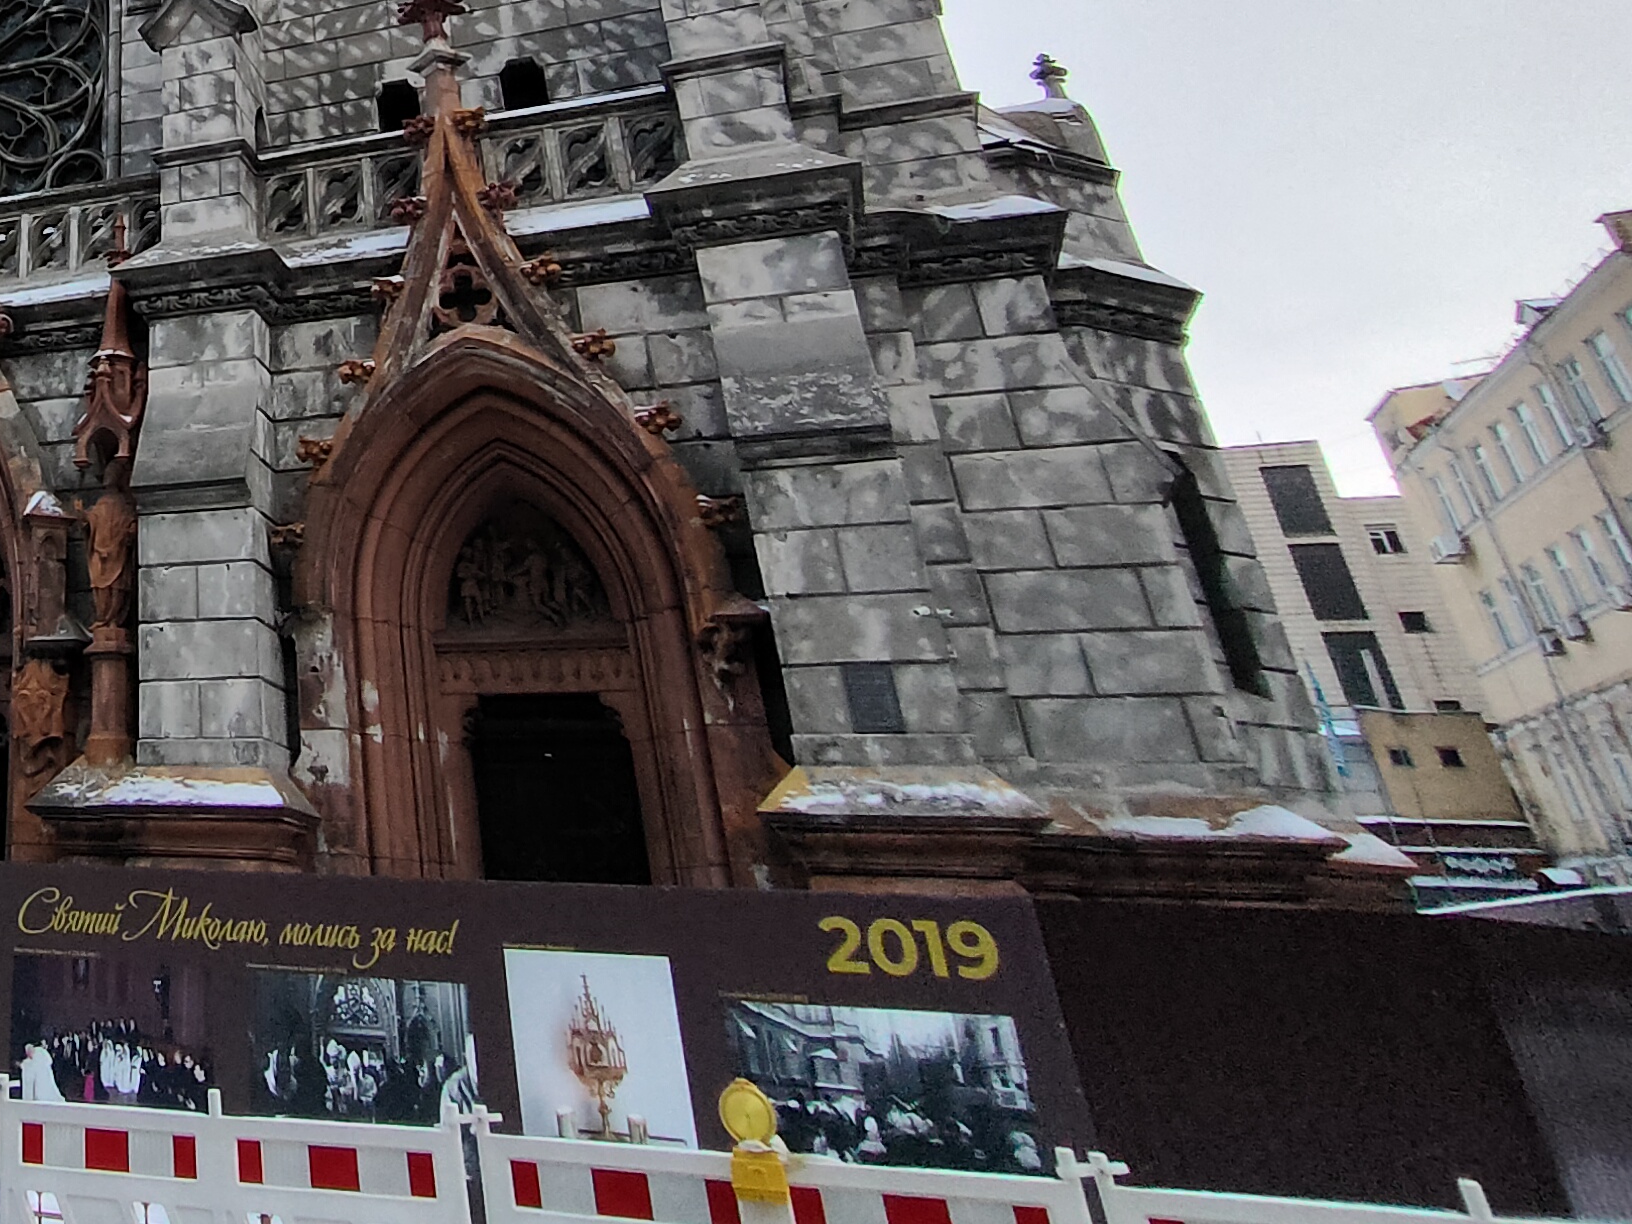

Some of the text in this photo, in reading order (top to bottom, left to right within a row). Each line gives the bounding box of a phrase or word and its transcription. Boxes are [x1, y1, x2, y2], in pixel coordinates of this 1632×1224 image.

[17, 887, 460, 969] Святий Миколаю, молись за нас!
[818, 915, 1000, 980] 2019
